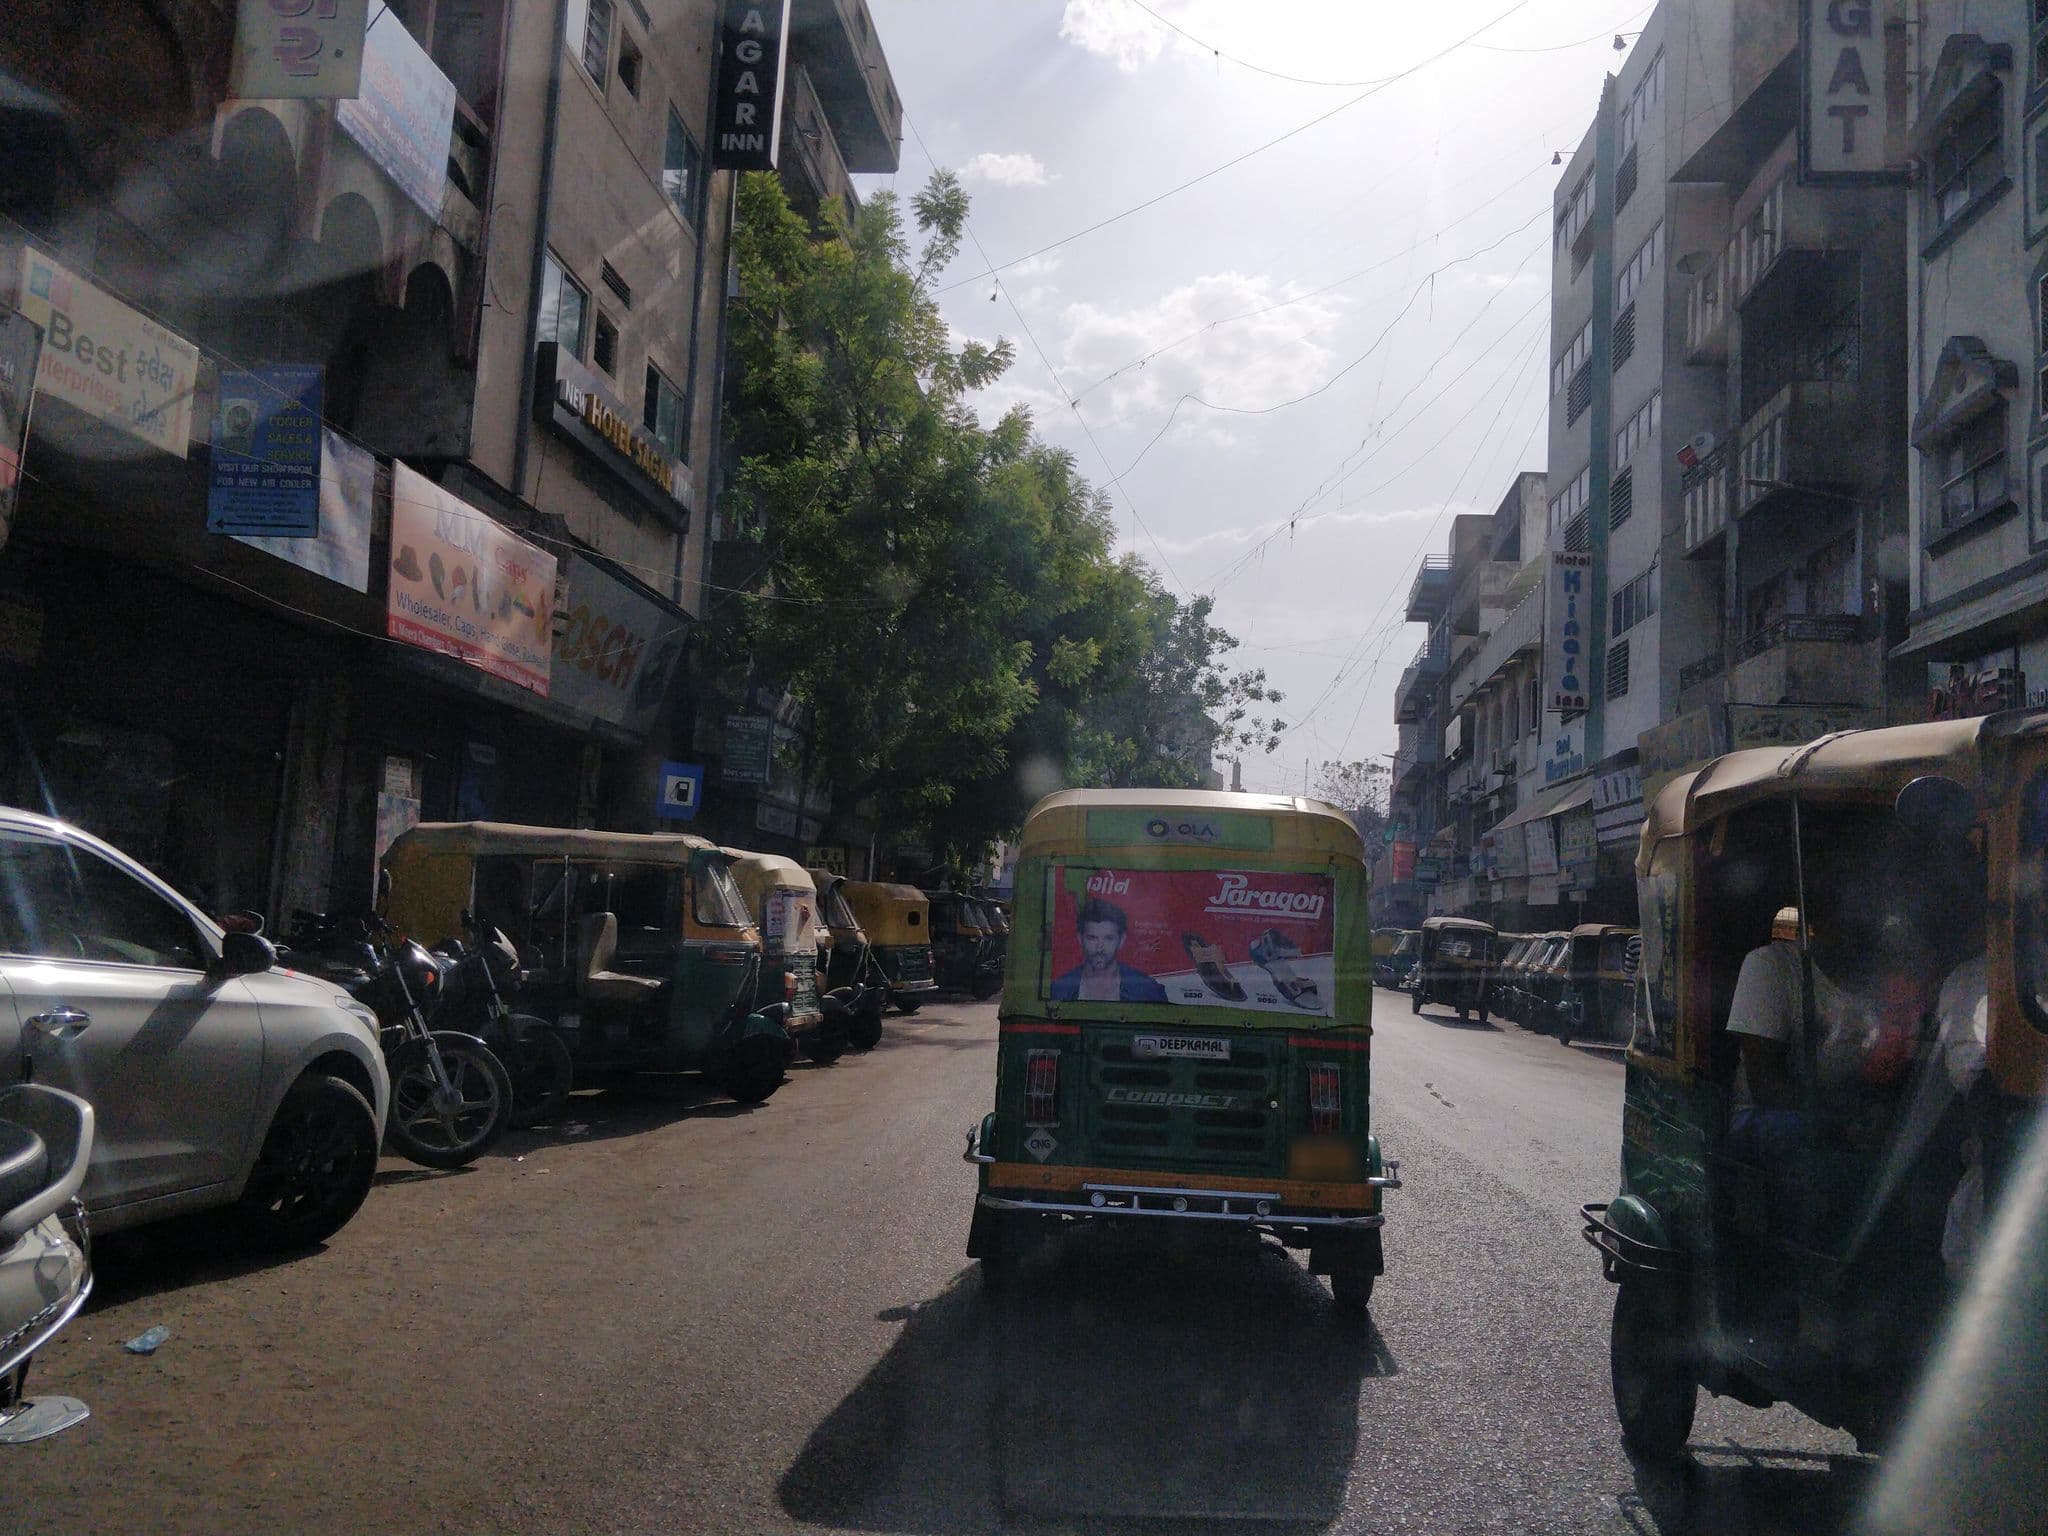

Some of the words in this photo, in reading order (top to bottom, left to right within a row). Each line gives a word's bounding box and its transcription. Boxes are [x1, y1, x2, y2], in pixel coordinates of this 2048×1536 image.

[721, 133, 764, 152] INN
[47, 309, 128, 384] Best
[268, 415, 313, 427] COOLER
[562, 380, 586, 416] NEW
[589, 392, 632, 457] HOTEL
[267, 433, 303, 443] SALES
[217, 464, 240, 472] VISIT
[241, 464, 260, 473] OUR
[216, 478, 234, 486] FOR
[238, 478, 258, 487] NEW
[262, 479, 276, 488] AIR
[279, 480, 312, 488] COOLER
[1555, 553, 1591, 566] Hotel
[556, 601, 646, 689] OSCH
[1556, 691, 1584, 707] inn
[1178, 823, 1215, 837] OLA
[1205, 873, 1325, 919] Paragon
[1159, 1038, 1224, 1053] DEEPKAMAL
[1030, 1139, 1051, 1149] CNG
